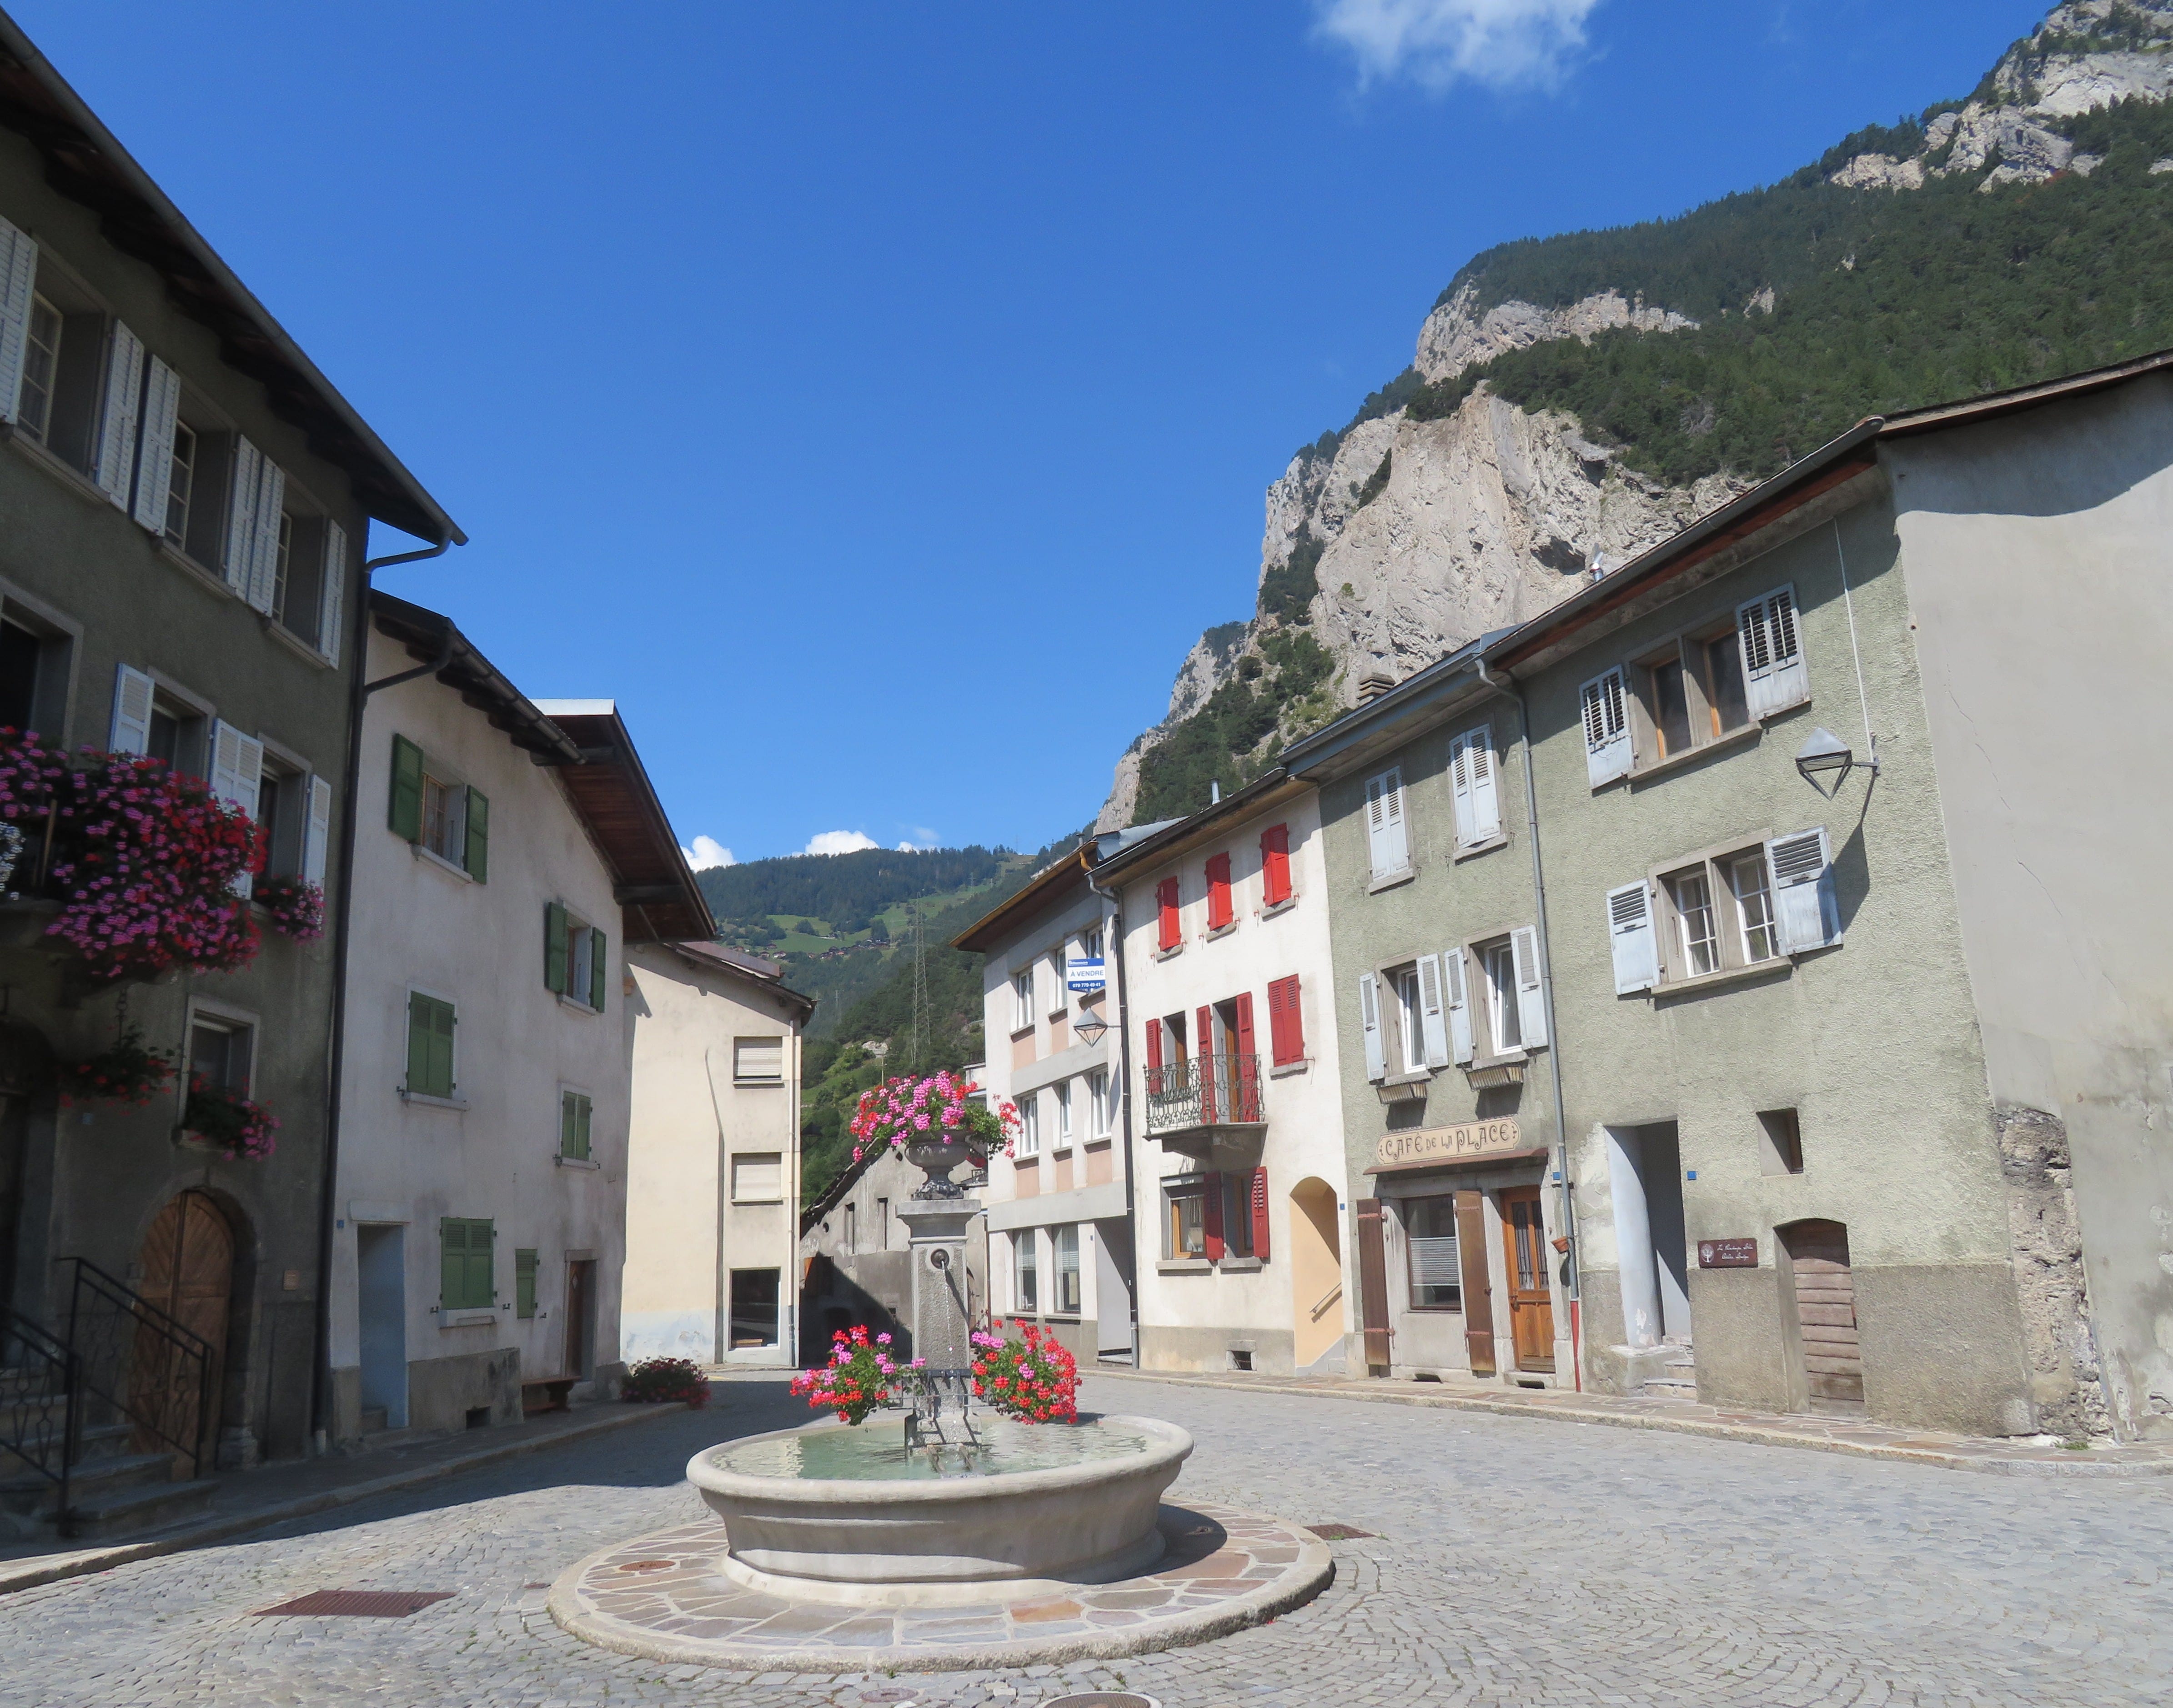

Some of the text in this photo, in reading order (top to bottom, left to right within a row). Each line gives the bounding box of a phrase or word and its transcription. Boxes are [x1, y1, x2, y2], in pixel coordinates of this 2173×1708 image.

[1385, 1132, 1423, 1160] CAFÉ
[1441, 1136, 1453, 1149] LA
[1456, 1123, 1509, 1152] PLACE
